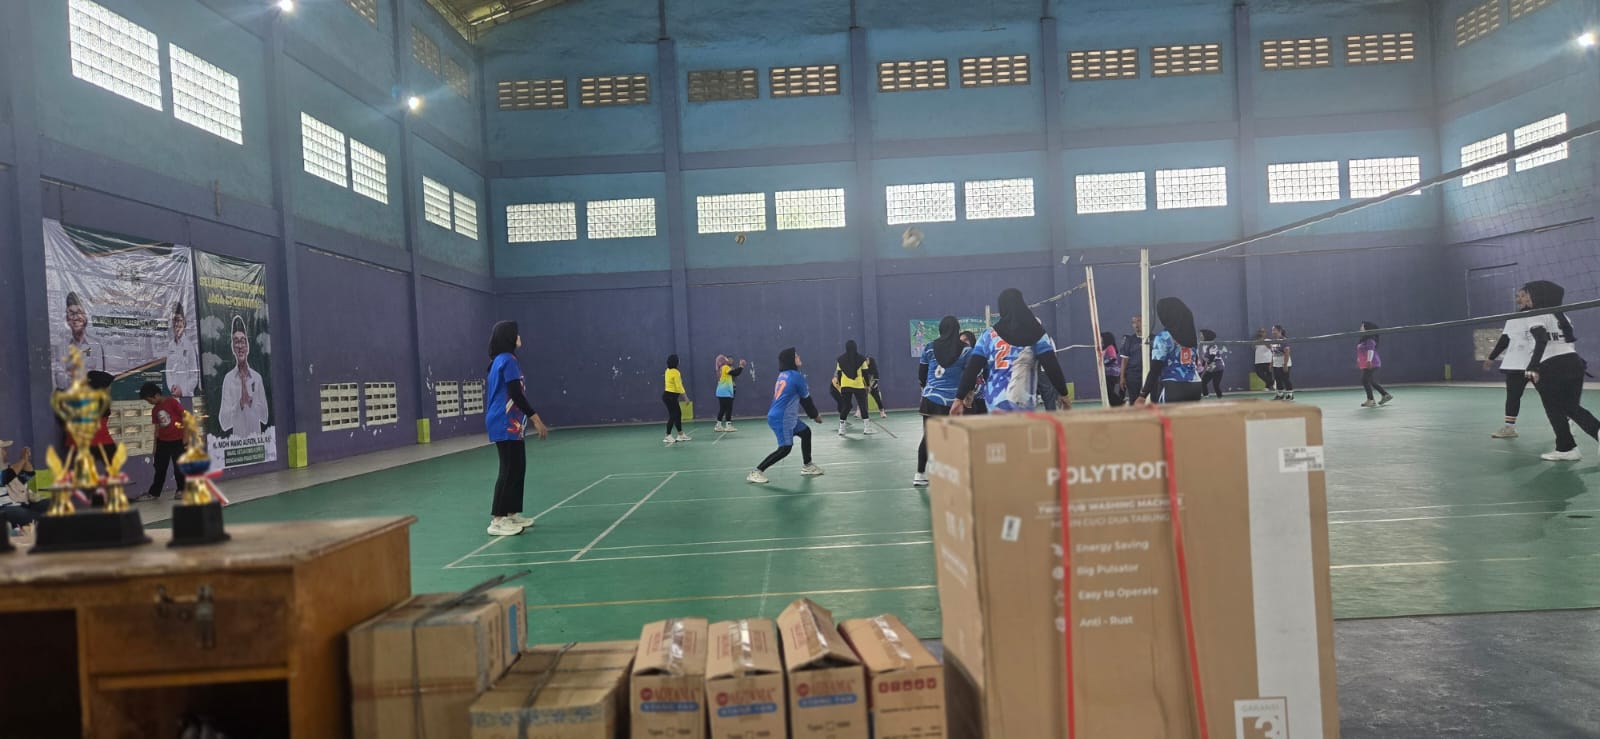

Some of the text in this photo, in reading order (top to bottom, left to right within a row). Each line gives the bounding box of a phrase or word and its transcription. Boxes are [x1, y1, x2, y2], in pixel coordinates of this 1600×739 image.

[1046, 460, 1170, 486] POLYTRON
[1075, 540, 1150, 553] Energy Saving
[1096, 564, 1138, 574] Pulsator
[1078, 587, 1159, 601] Easy to Operate
[1080, 618, 1101, 627] Anti
[1109, 616, 1134, 625] Rust
